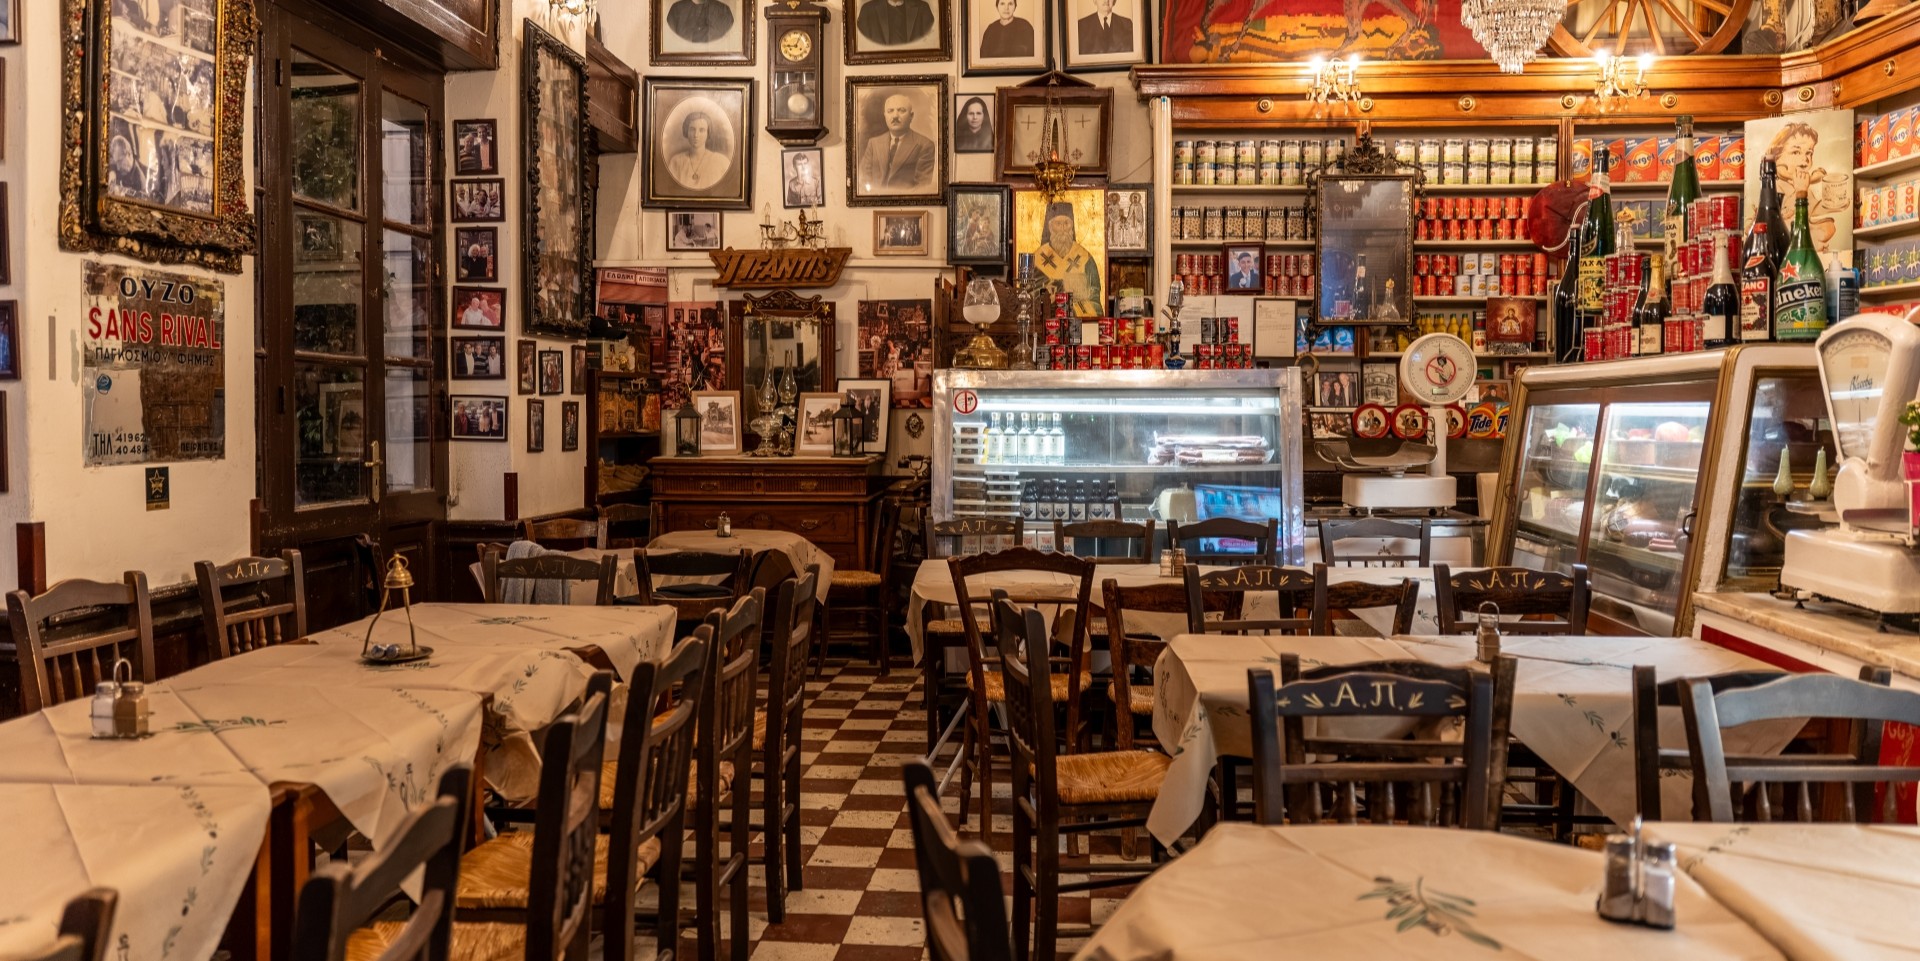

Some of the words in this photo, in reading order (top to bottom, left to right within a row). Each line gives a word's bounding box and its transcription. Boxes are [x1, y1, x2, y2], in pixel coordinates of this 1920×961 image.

[1626, 153, 1655, 167] Target
[1695, 151, 1720, 163] arget
[1870, 194, 1879, 220] OMO
[1905, 186, 1914, 214] OMO
[120, 276, 195, 306] ΟΥΖΟ
[88, 307, 153, 345] SANS
[160, 312, 222, 350] RIVAL
[95, 346, 170, 364] ΠΑΓΚΟΣΜΙΟΥ
[177, 353, 215, 366] ΦΗΜΗΣ
[1470, 413, 1492, 432] Tide
[115, 433, 146, 443] 41962
